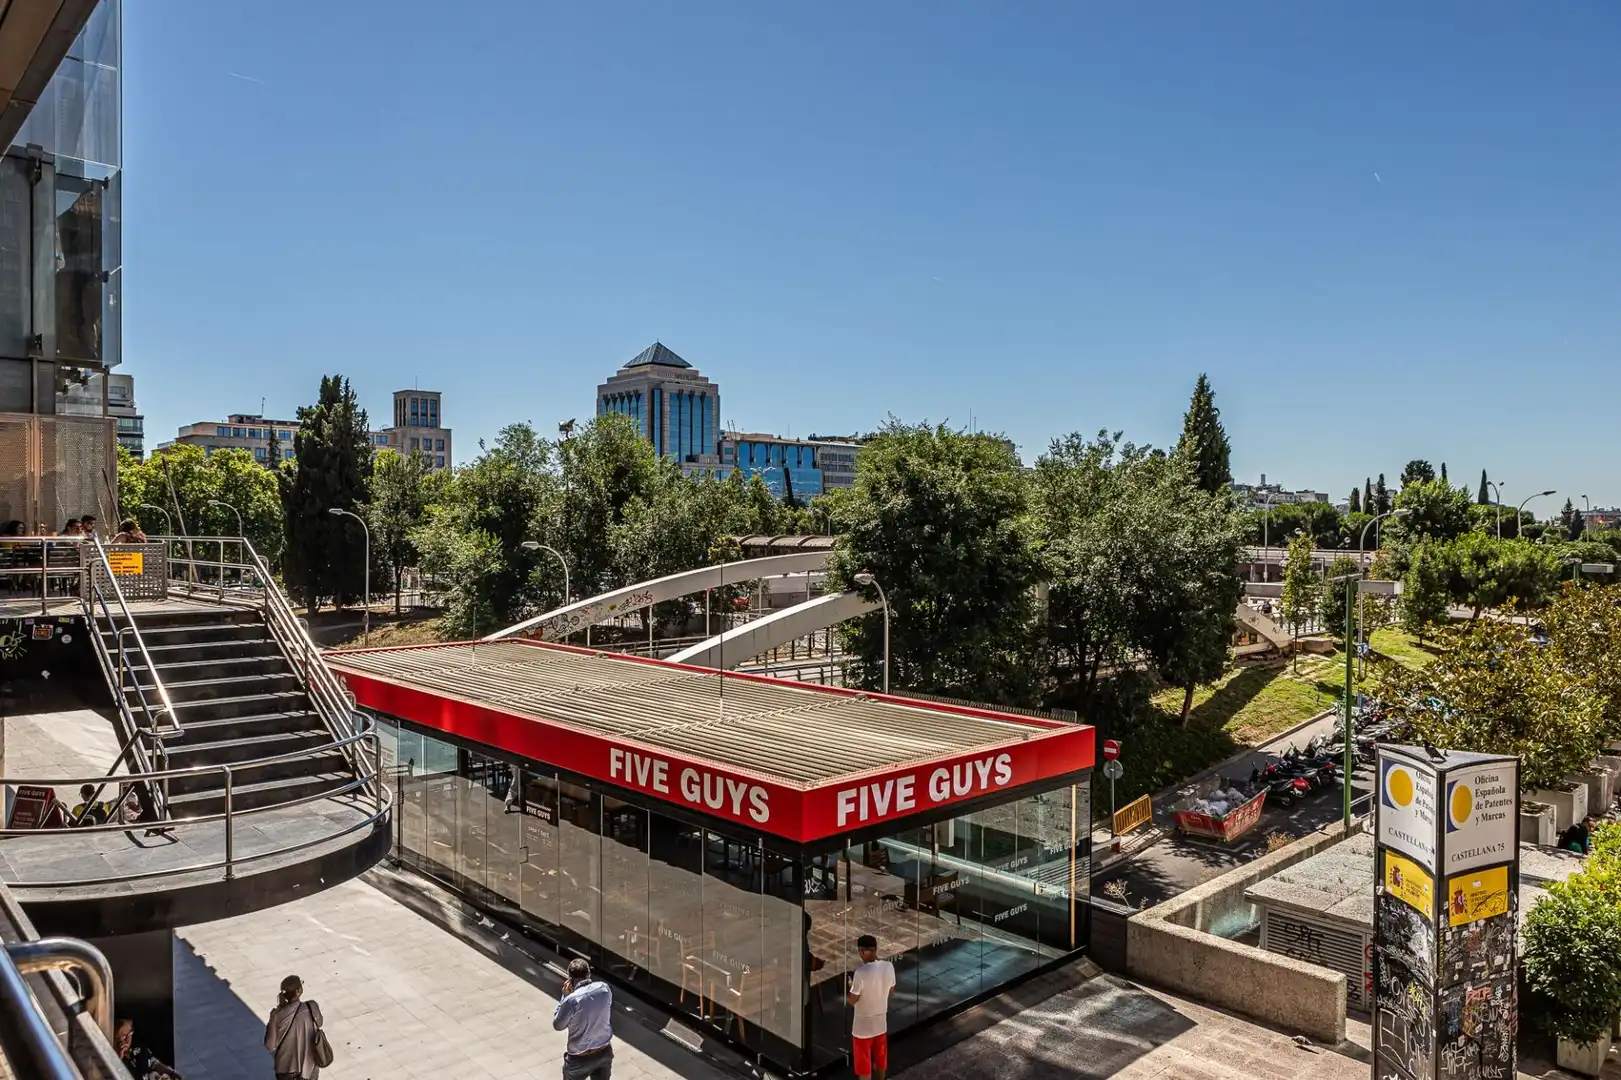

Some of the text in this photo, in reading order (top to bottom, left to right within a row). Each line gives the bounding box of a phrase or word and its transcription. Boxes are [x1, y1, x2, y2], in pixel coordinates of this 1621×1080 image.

[610, 747, 770, 824] FIVE GUYS
[1474, 774, 1499, 785] Oficina
[837, 753, 1012, 828] FIVE GUYS
[1475, 785, 1506, 799] Española
[1475, 798, 1513, 810] de Patentes
[526, 805, 537, 815] FIVE
[537, 810, 551, 820] GUYS
[1475, 811, 1506, 826] y Marcas
[1064, 840, 1080, 850] GUS
[1451, 845, 1496, 862] CASTELLANA
[1497, 842, 1505, 852] 75
[1010, 856, 1028, 868] GUYS
[932, 876, 970, 896] FIVE GUYS
[994, 903, 1028, 923] FIVE GUYS
[730, 959, 751, 974] GUYS
